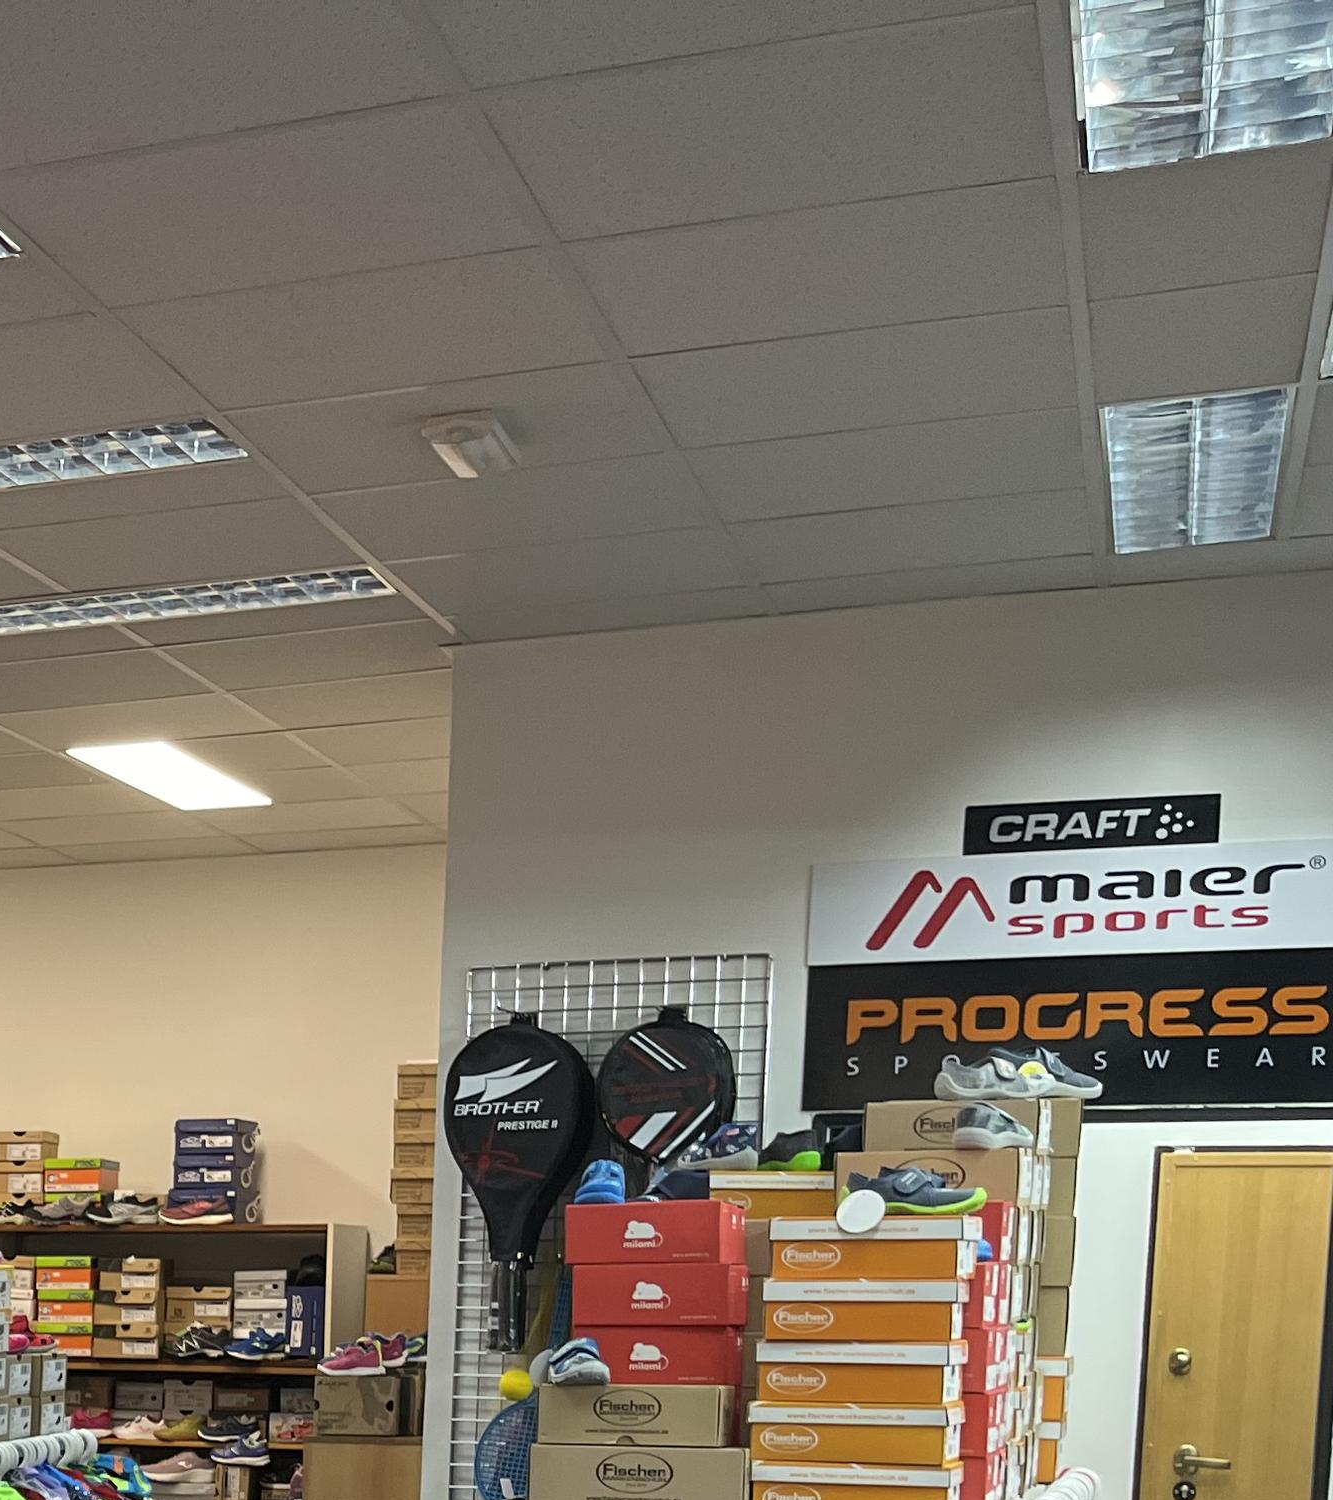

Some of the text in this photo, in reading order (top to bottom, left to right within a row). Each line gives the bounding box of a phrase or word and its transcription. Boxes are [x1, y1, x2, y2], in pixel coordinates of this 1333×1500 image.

[988, 807, 1152, 844] CRAFT
[1006, 904, 1270, 940] sports
[845, 985, 1331, 1046] PROGRESS
[845, 1045, 1327, 1077] SPSWEAR
[453, 1100, 541, 1117] BROTHER
[497, 1120, 550, 1131] PRESTIGE
[623, 1240, 657, 1249] milami
[786, 1249, 837, 1261] Fischer
[631, 1301, 665, 1310] milami
[778, 1311, 829, 1323] Fischer
[599, 1399, 656, 1412] Fischer
[603, 1463, 667, 1477] Fischer
